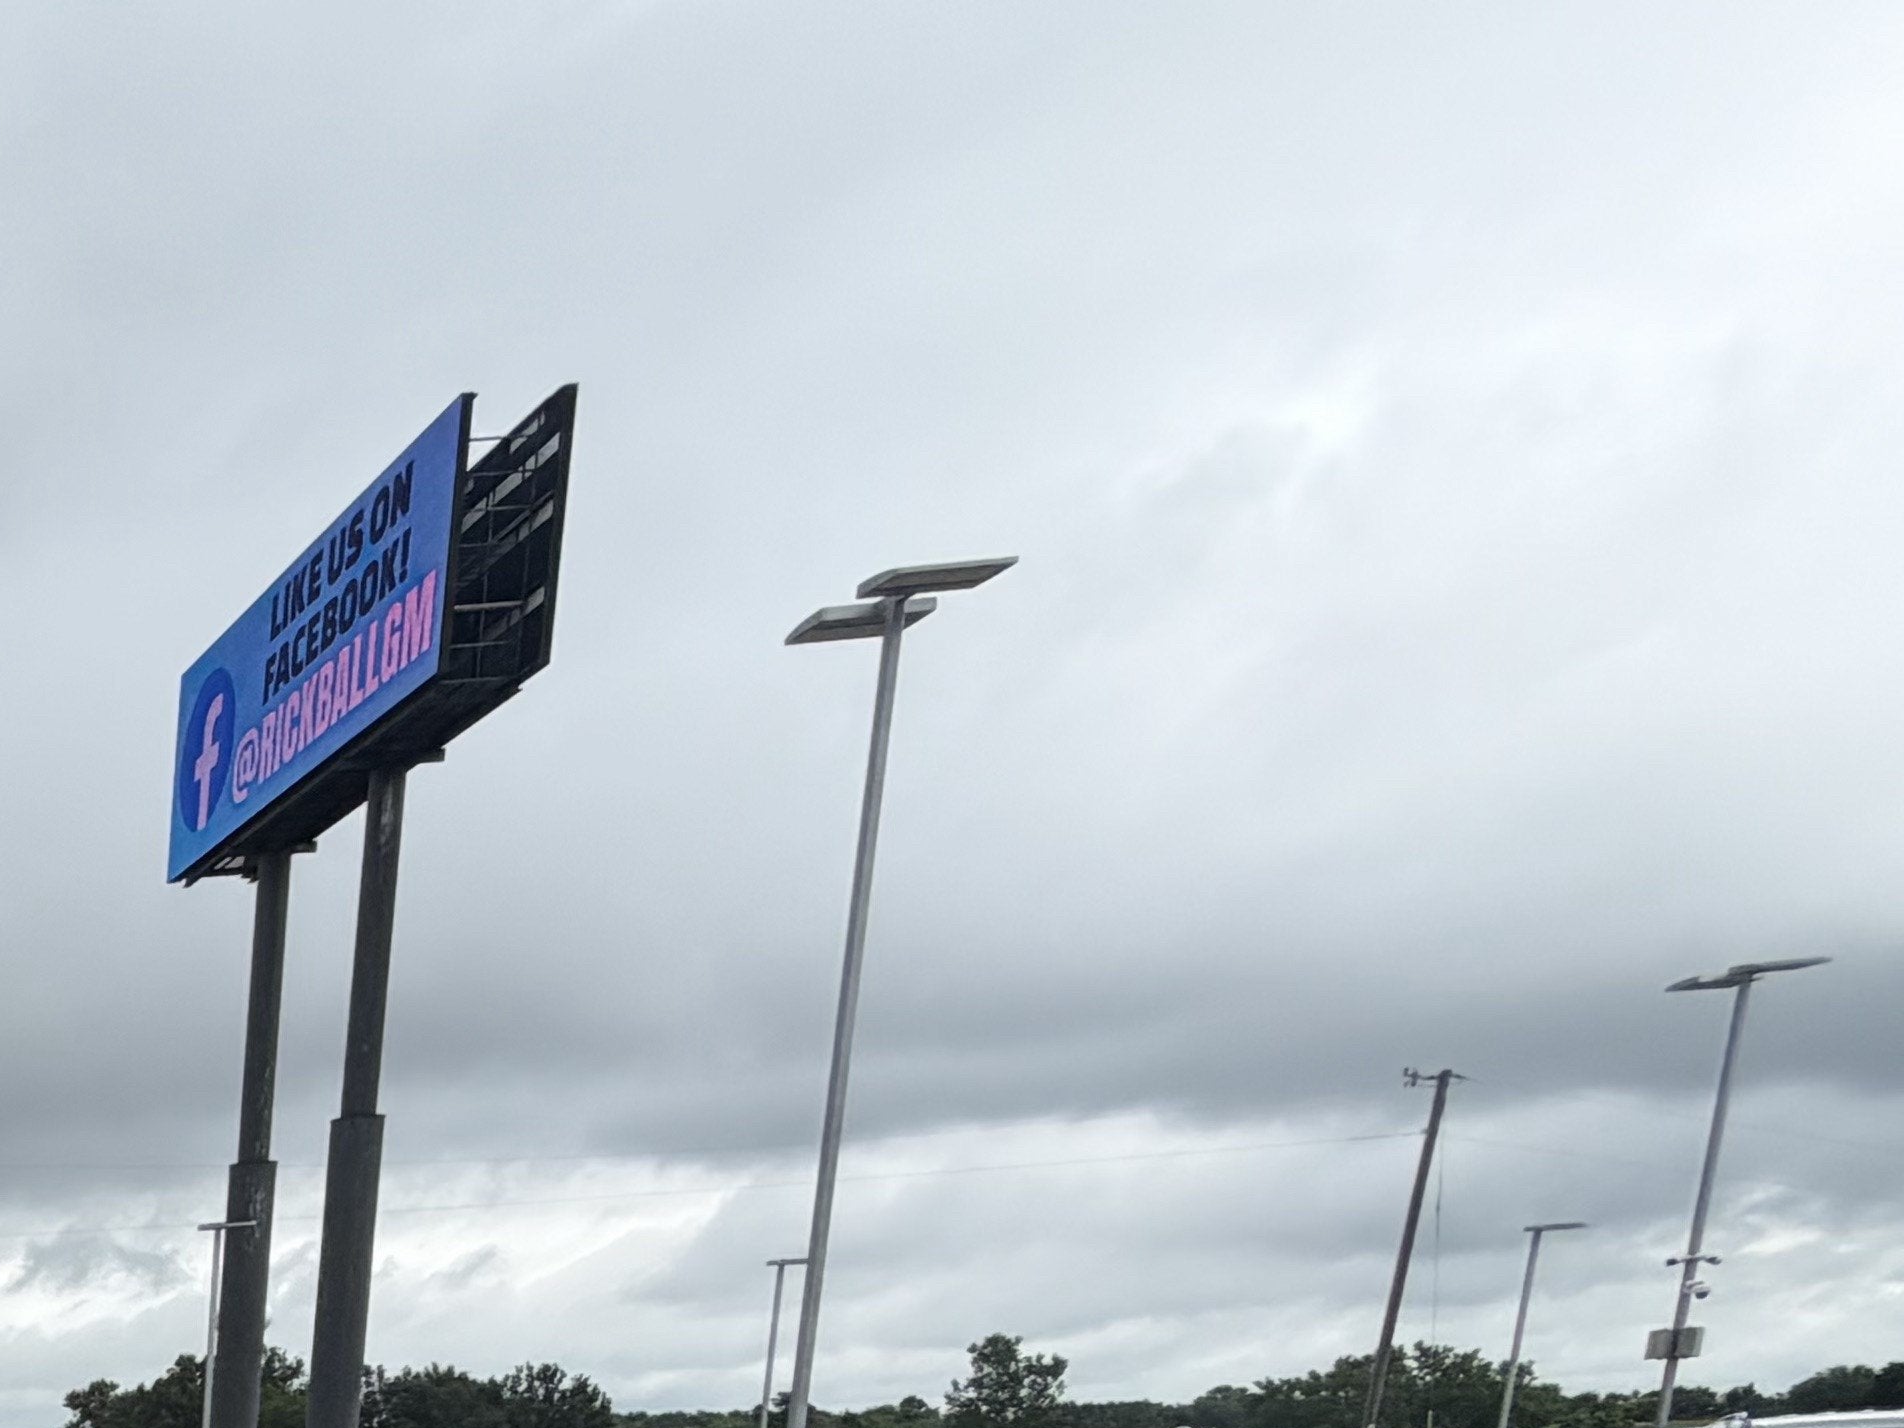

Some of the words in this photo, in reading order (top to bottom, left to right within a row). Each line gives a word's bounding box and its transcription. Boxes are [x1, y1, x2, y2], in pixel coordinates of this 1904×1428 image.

[262, 527, 411, 706] FACEBOOK!
[270, 557, 325, 641] LIKE
[328, 510, 364, 586] US
[370, 460, 414, 540] ON
[231, 570, 436, 804] @RICKBALLGM
